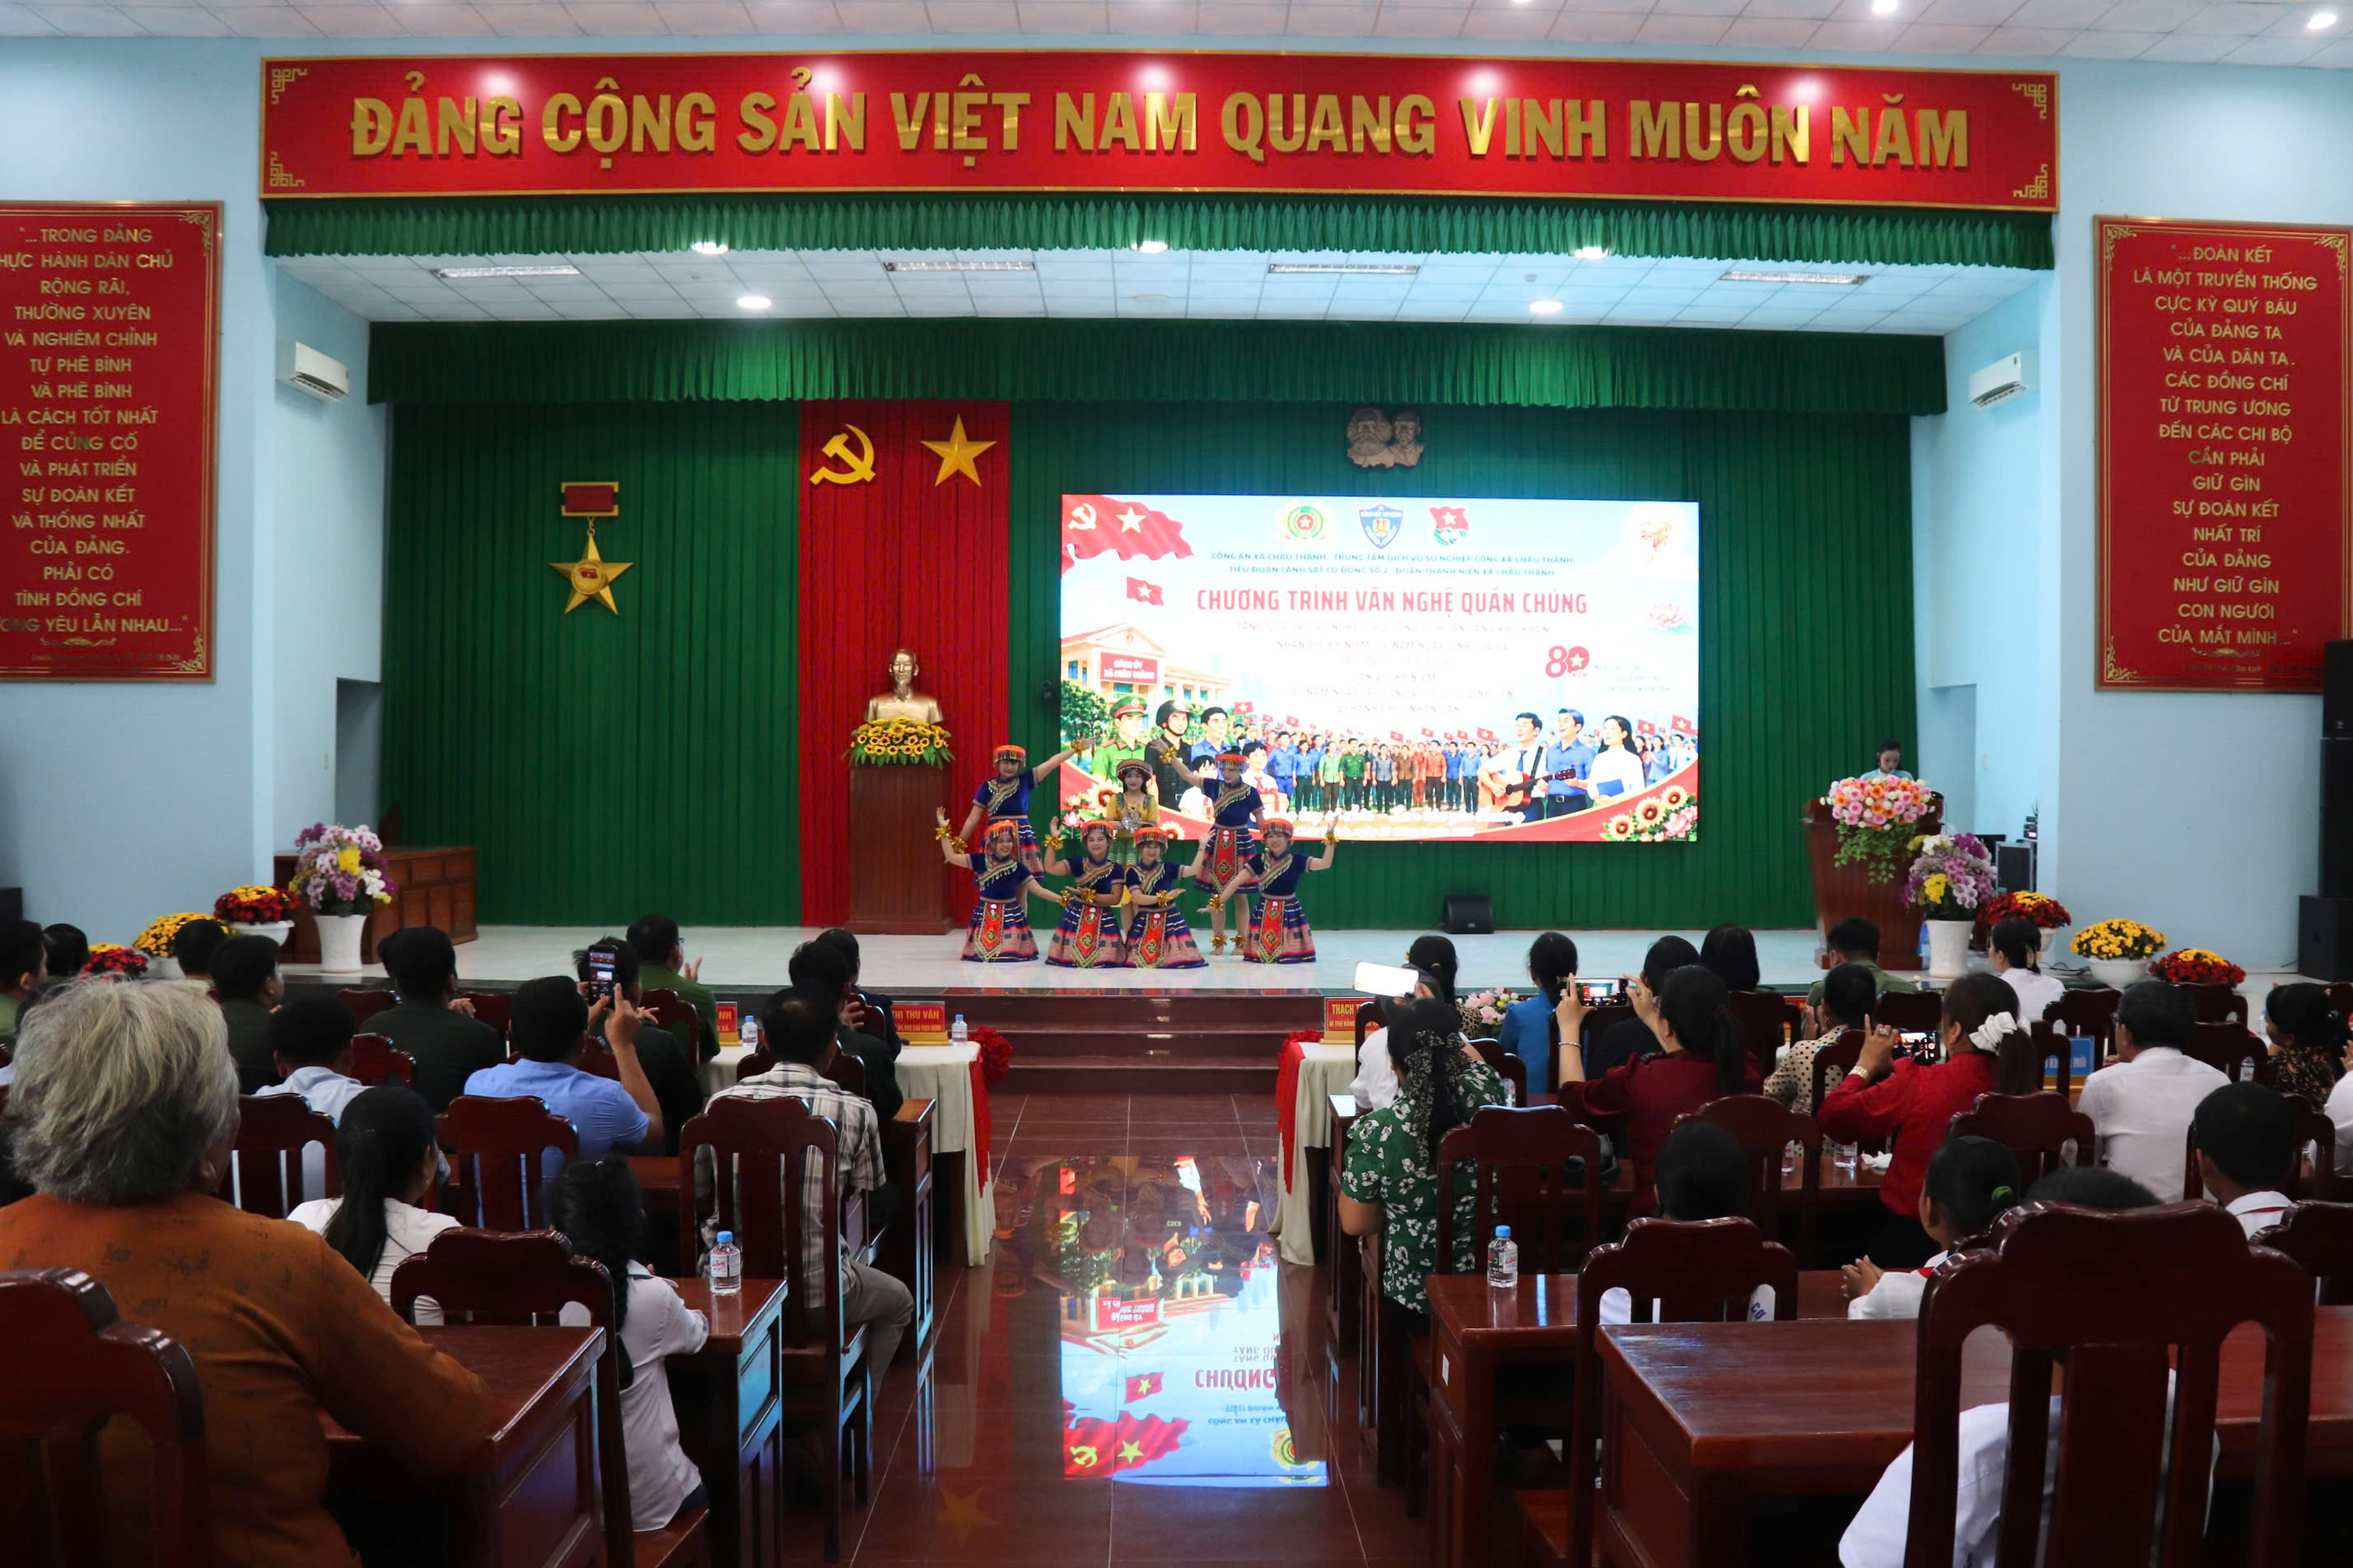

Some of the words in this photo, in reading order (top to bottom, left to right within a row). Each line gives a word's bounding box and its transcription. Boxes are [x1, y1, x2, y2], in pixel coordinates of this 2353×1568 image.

[351, 71, 523, 160] ĐẢNG
[542, 77, 717, 169] CỘNG
[737, 67, 866, 156] SẢN
[890, 73, 1030, 167] VIỆT
[1054, 91, 1198, 152] NAM
[1221, 91, 1435, 162] QUANG
[1457, 97, 1607, 161] VINH
[1629, 84, 1810, 164] MUÔN
[1831, 92, 1969, 168] NĂM
[104, 223, 152, 242] ĐẢNG
[0, 252, 33, 272] HỰC
[42, 251, 87, 268] HÀNH
[94, 251, 128, 268] DÂN
[136, 249, 173, 268] CHỦ
[2245, 245, 2272, 263] KẾT
[40, 277, 91, 296] RỘNG
[2134, 267, 2153, 283] LÀ
[2158, 268, 2192, 288] MỘT
[2197, 268, 2257, 287] TRUYỀN
[2262, 271, 2318, 290] THỐNG
[15, 302, 86, 320] THƯỜNG
[92, 303, 151, 320] XUYÊN
[2155, 295, 2192, 314] CỰC
[2198, 295, 2218, 311] KỲ
[2224, 296, 2259, 313] QUÝ
[2266, 298, 2297, 315] BÁU
[5, 329, 26, 346] VÀ
[33, 329, 100, 346] NGHIÊM
[106, 327, 156, 346] CHỈNH
[2171, 318, 2206, 336] CỦA
[2211, 319, 2259, 338] ĐẢNG
[2265, 326, 2282, 339] TA
[2164, 345, 2183, 362] VÀ
[2190, 344, 2225, 362] CỦA
[2232, 348, 2264, 364] DÂN
[30, 357, 52, 376] TỰ
[57, 356, 89, 372] PHÊ
[95, 356, 132, 372] BÌNH
[31, 381, 53, 398] VÀ
[58, 381, 88, 398] PHÊ
[95, 381, 132, 398] BÌNH
[2166, 371, 2201, 388] CÁC
[2207, 370, 2255, 390] ĐỒNG
[2260, 374, 2289, 390] CHÍ
[1, 407, 21, 424] LÀ
[27, 407, 76, 424] CÁCH
[83, 405, 110, 424] TỐT
[117, 405, 158, 424] NHẤT
[2160, 396, 2180, 412] TỪ
[2186, 399, 2238, 414] TRUNG
[2243, 400, 2291, 416] ƯƠNG
[21, 429, 45, 450] ĐỂ
[51, 432, 104, 450] CỦNG
[110, 432, 138, 450] CỐ
[2159, 419, 2192, 438] ĐẾN
[2198, 423, 2234, 440] CÁC
[2239, 427, 2266, 441] CHI
[2271, 425, 2292, 445] BỘ
[20, 459, 42, 476] VÀ
[49, 459, 89, 476] PHÁT
[93, 455, 137, 476] TRIỂN
[2188, 446, 2224, 464] CẦN
[2230, 447, 2265, 466] PHẢI
[2193, 473, 2224, 490] GIỮ
[2230, 474, 2260, 491] GÌN
[22, 487, 45, 506] SỰ
[50, 485, 99, 502] ĐOÀN
[105, 483, 135, 502] KẾT
[2173, 499, 2194, 518] SỰ
[2199, 500, 2247, 517] ĐOÀN
[2252, 498, 2280, 517] KẾT
[12, 511, 33, 528] VÀ
[39, 509, 95, 528] THỐNG
[103, 509, 145, 528] NHẤT
[2194, 523, 2233, 541] NHẤT
[2239, 525, 2261, 542] TRÍ
[30, 535, 68, 554] CỦA
[75, 534, 129, 554] ĐẢNG.
[2183, 548, 2217, 567] CỦA
[2225, 548, 2271, 567] ĐẢNG
[44, 561, 82, 580] PHẢI
[87, 563, 114, 580] CÓ
[2173, 576, 2210, 592] NHƯ
[2215, 576, 2243, 593] GIỮ
[2248, 577, 2279, 593] GÌN
[16, 590, 49, 606] TÌNH
[56, 587, 106, 606] ĐỒNG
[113, 589, 142, 606] CHÍ
[1198, 588, 1279, 610] CHƯƠNG
[1356, 587, 1394, 612] VĂN
[1403, 587, 1454, 618] NGHỆ
[2178, 603, 2215, 618] CON
[2220, 603, 2275, 619] NGƯƠI
[46, 615, 77, 632] YÊU
[84, 613, 115, 632] LẪN
[2159, 623, 2192, 643] CỦA
[2201, 624, 2232, 644] MẮT
